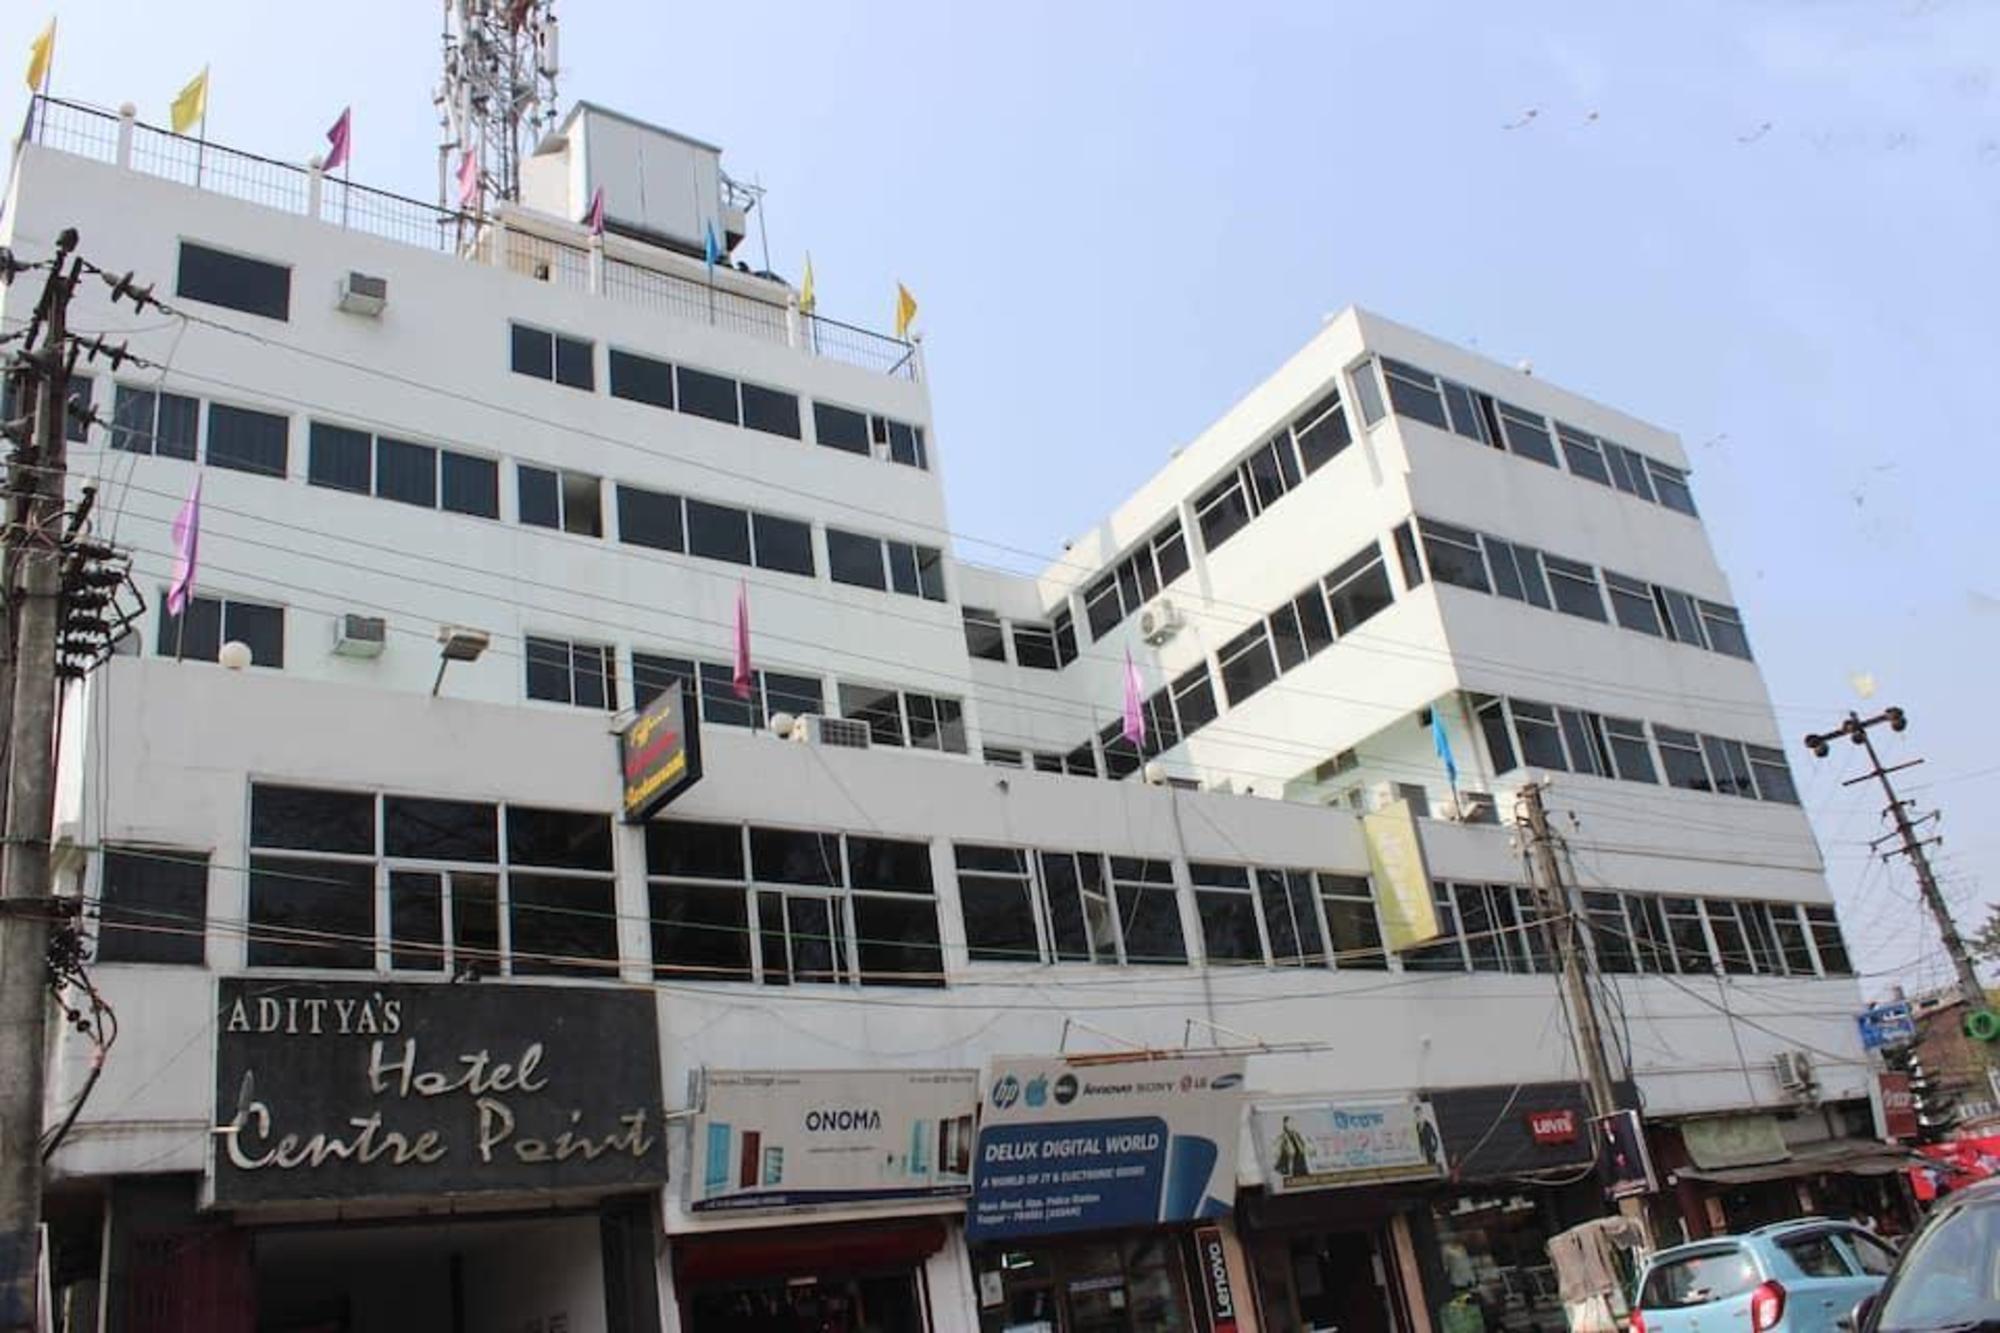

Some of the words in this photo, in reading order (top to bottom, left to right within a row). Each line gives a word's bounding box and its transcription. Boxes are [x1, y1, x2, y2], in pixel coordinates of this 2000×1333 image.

[226, 992, 402, 1034] ADITYA'S
[368, 1037, 548, 1098] Hotel
[227, 1101, 448, 1170] Centre
[477, 1099, 655, 1166] Point
[806, 1110, 881, 1132] ONOMA
[985, 1142, 1039, 1162] DELUX
[1042, 1137, 1101, 1158] DIGITAL
[1106, 1133, 1160, 1153] WORLD
